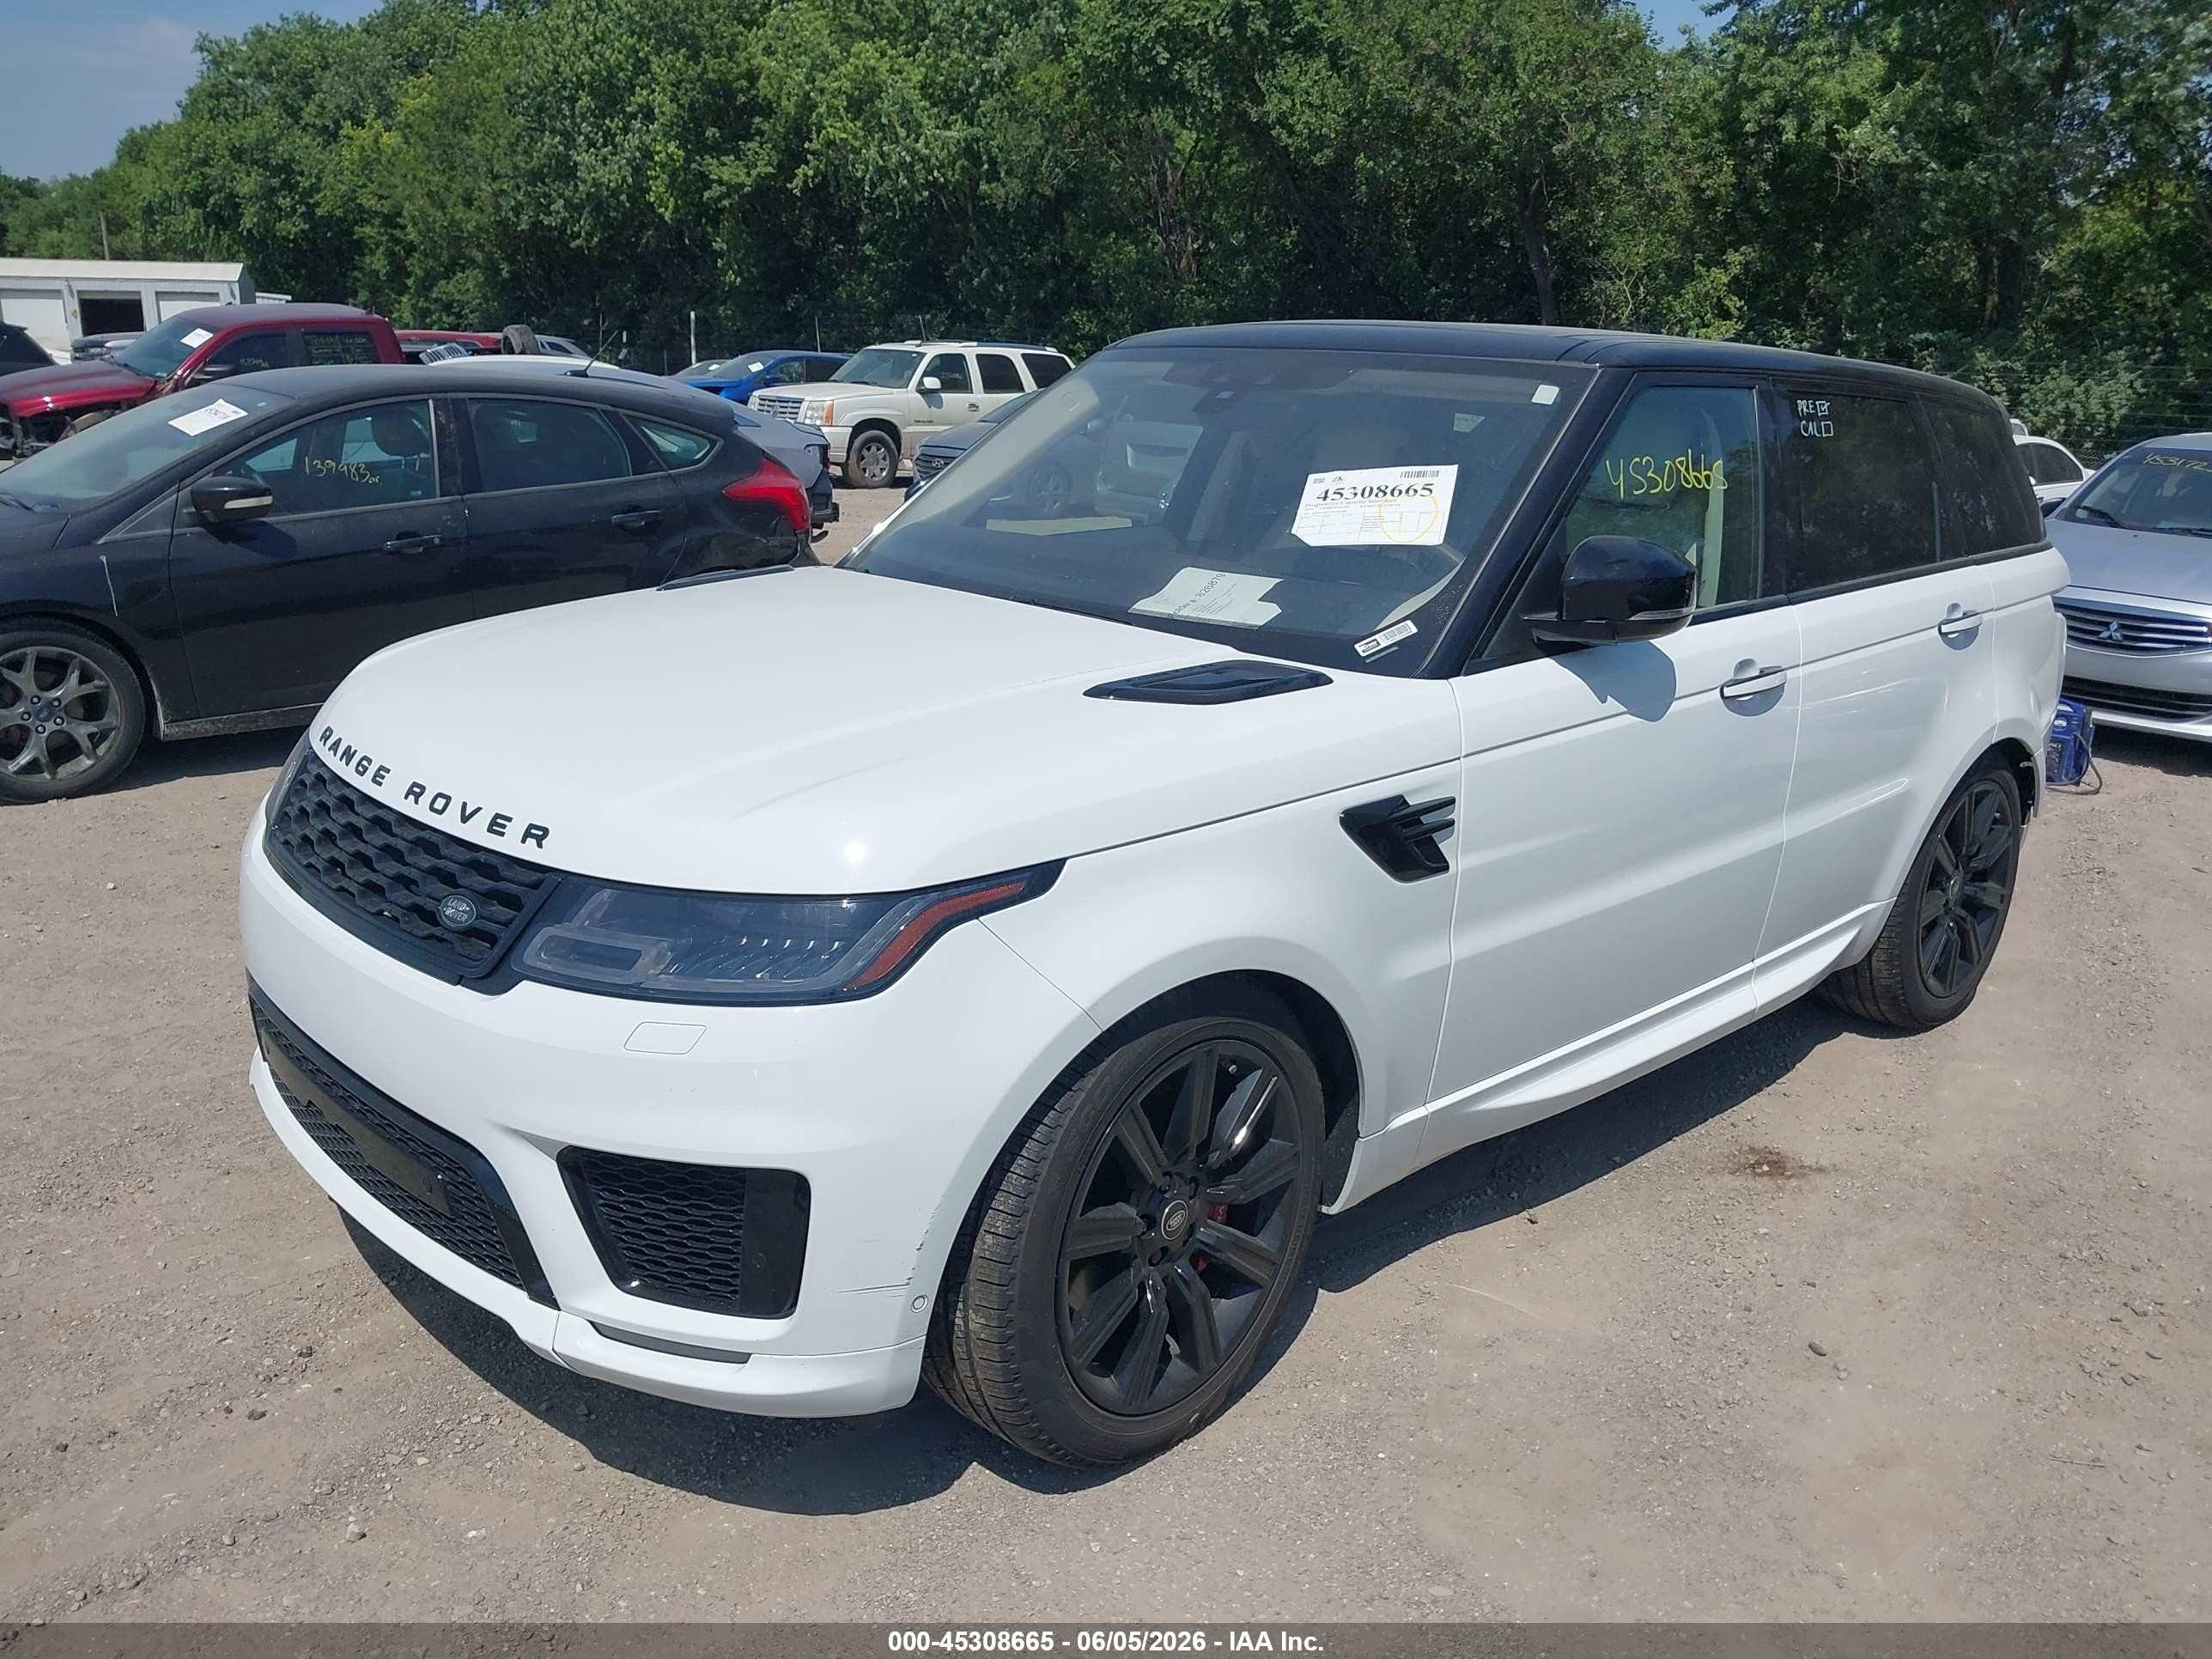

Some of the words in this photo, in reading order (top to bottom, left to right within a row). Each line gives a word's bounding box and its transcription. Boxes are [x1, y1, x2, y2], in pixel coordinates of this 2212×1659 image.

[1796, 399, 1816, 416] PRE
[1801, 420, 1821, 436] CAL
[1606, 448, 1728, 500] 45308665
[1316, 483, 1435, 501] 45308665
[319, 726, 392, 787] RANGE
[404, 781, 550, 849] ROVER
[447, 897, 467, 911] LAND
[445, 907, 468, 923] ROVER
